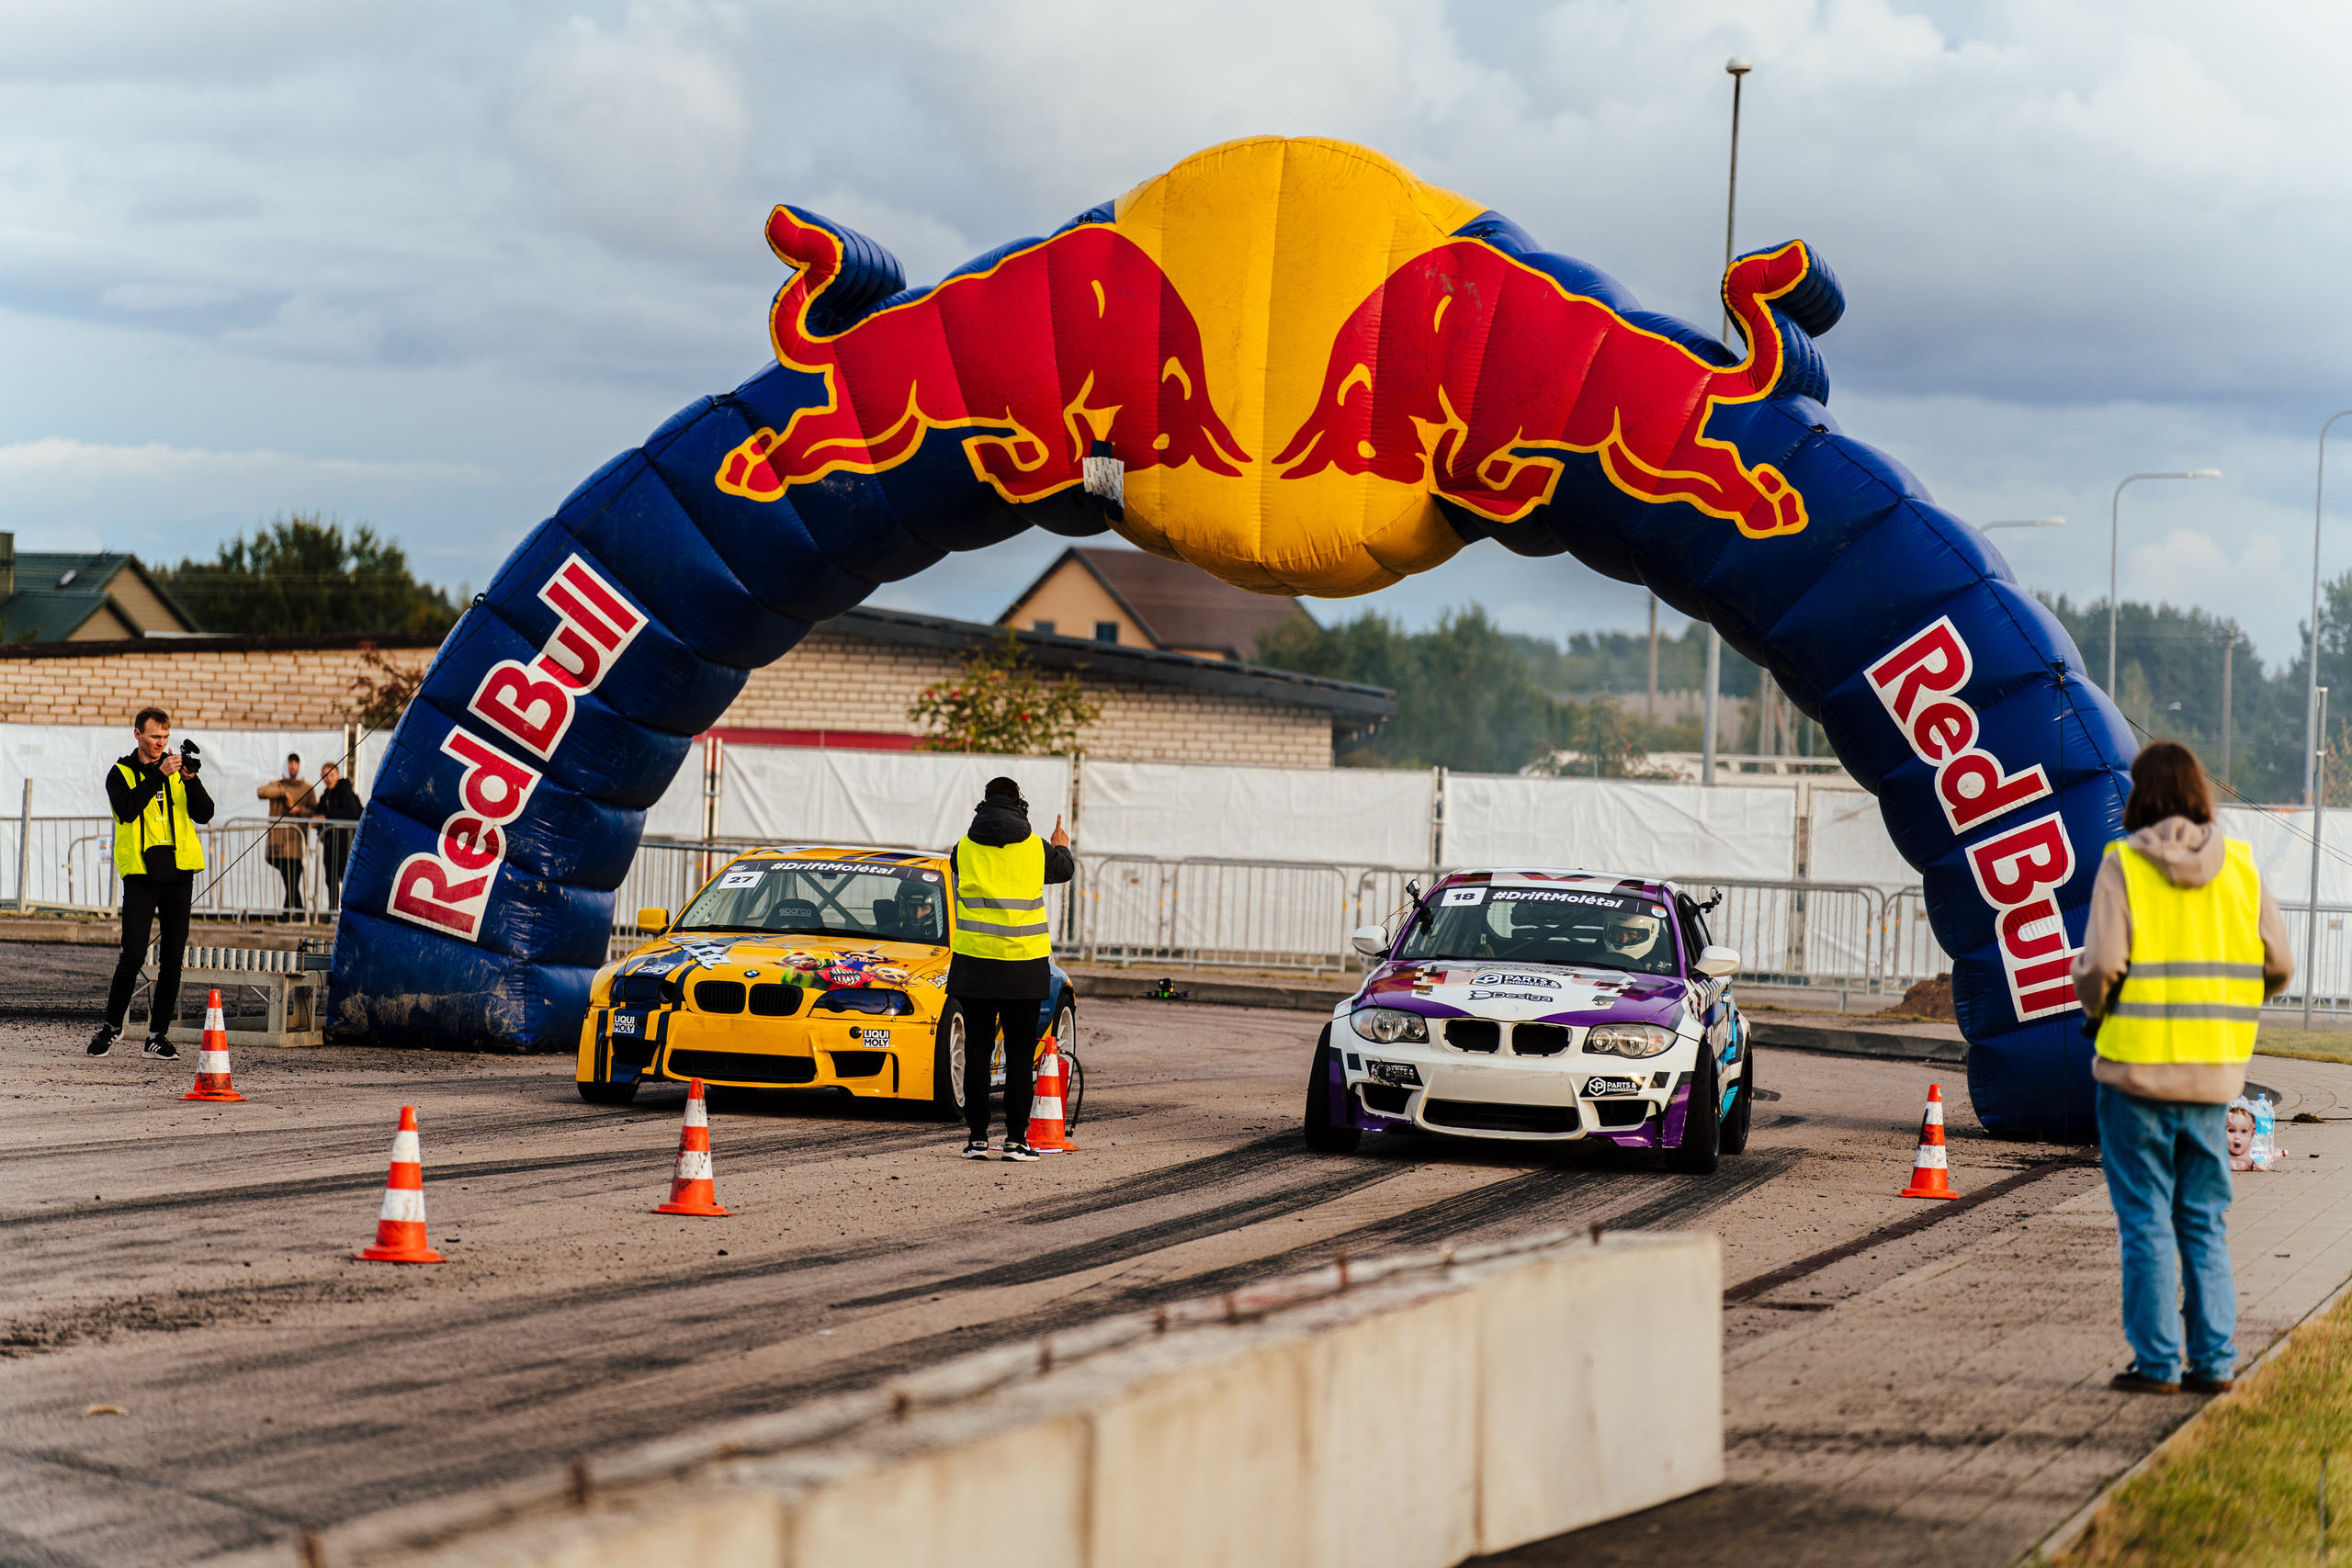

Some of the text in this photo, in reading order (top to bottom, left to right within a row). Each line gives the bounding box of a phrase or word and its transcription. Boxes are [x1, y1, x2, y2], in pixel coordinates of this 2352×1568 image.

[391, 560, 639, 936] Red Bull
[1870, 622, 2084, 1016] Red Bull
[728, 875, 754, 884] 27
[1453, 893, 1476, 901] 18
[1504, 975, 1548, 984] PARTS
[614, 1015, 635, 1024] LIQUI
[614, 1024, 634, 1032] MOLY
[864, 1030, 888, 1039] LIQUI
